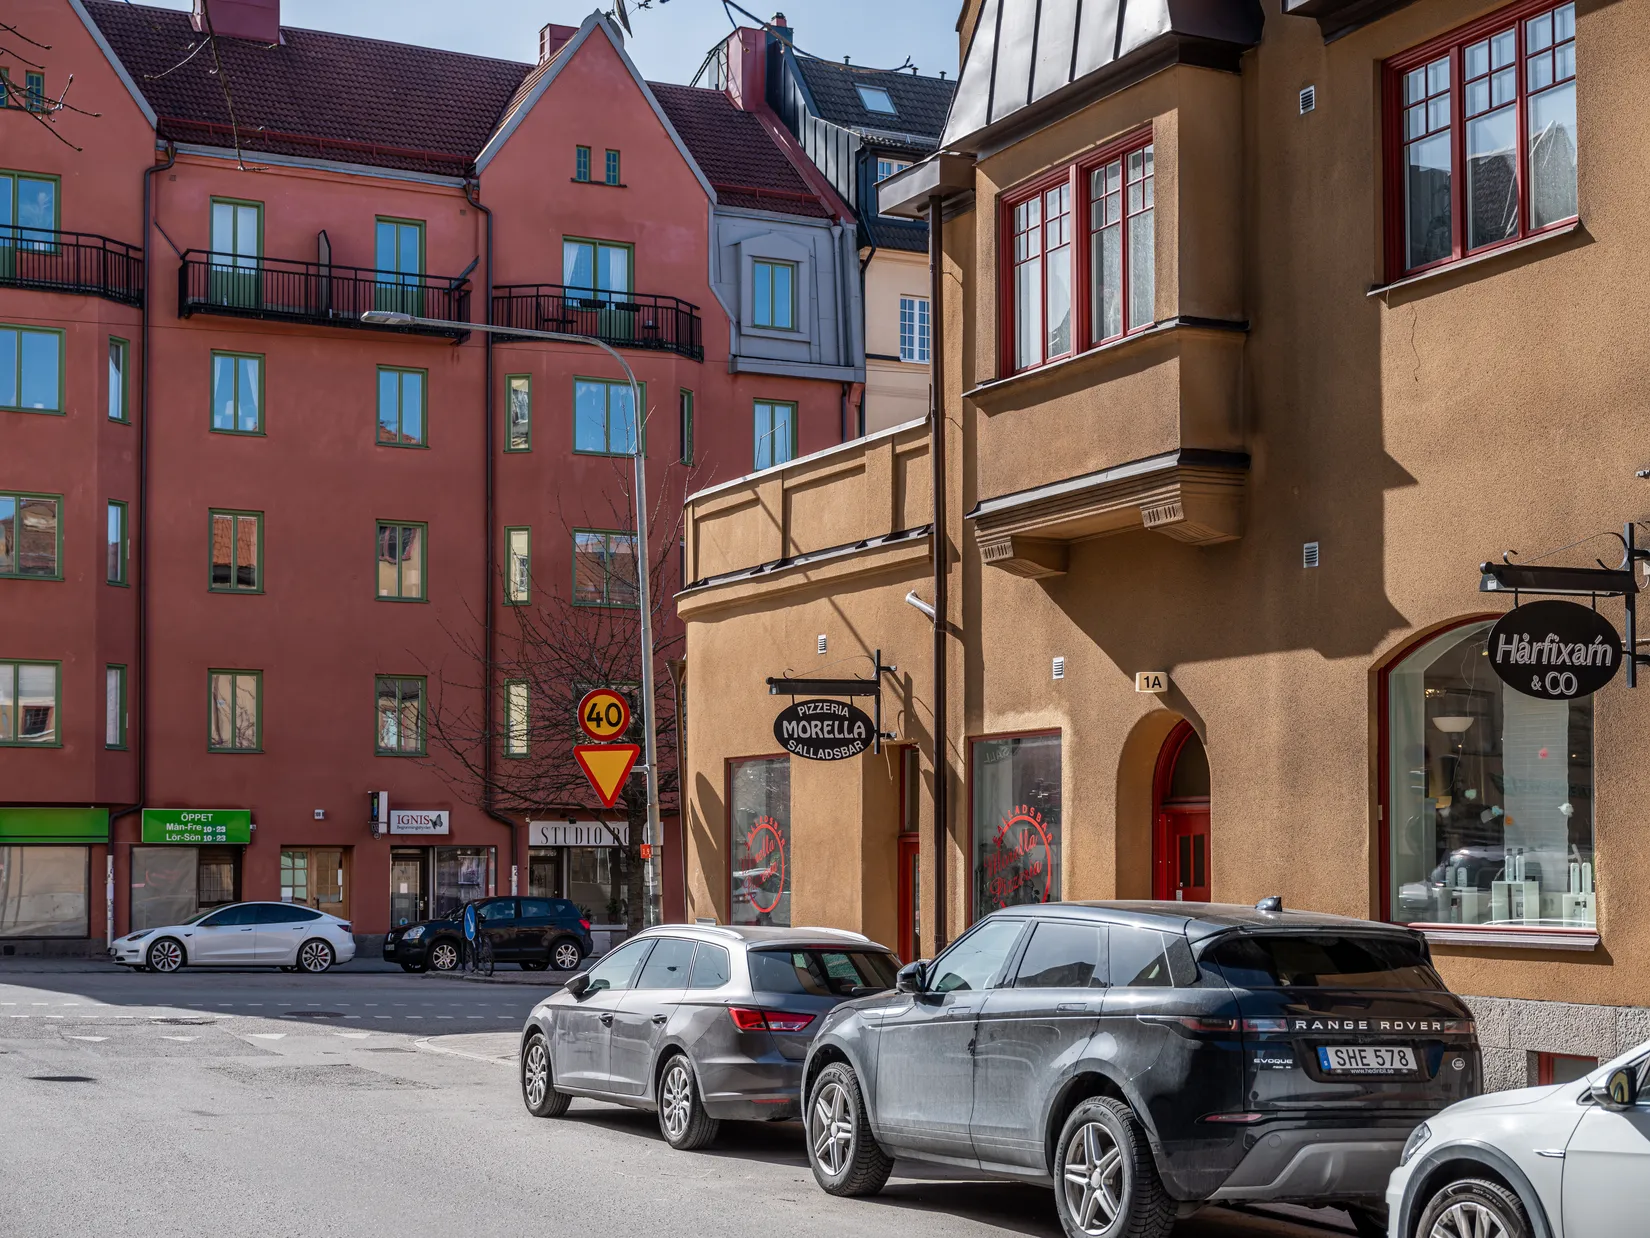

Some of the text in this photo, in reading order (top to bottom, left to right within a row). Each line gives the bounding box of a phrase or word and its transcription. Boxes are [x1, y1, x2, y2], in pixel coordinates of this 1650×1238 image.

[1143, 675, 1162, 689] 1A
[1531, 671, 1578, 696] & CO
[586, 702, 622, 728] 40
[797, 702, 850, 718] PIZZERIA
[782, 720, 866, 739] MORELLA
[787, 739, 864, 760] SALLADSBAR
[181, 812, 213, 822] ÖPPET
[397, 814, 430, 825] IGNIS
[992, 804, 1053, 844] SALLADSBAR
[166, 823, 202, 831] Mån-Fre
[541, 826, 602, 845] STUDIO
[166, 833, 201, 841] Lör-Sön
[1295, 1020, 1441, 1031] RANGE ROVER
[1334, 1048, 1409, 1067] SHE 578
